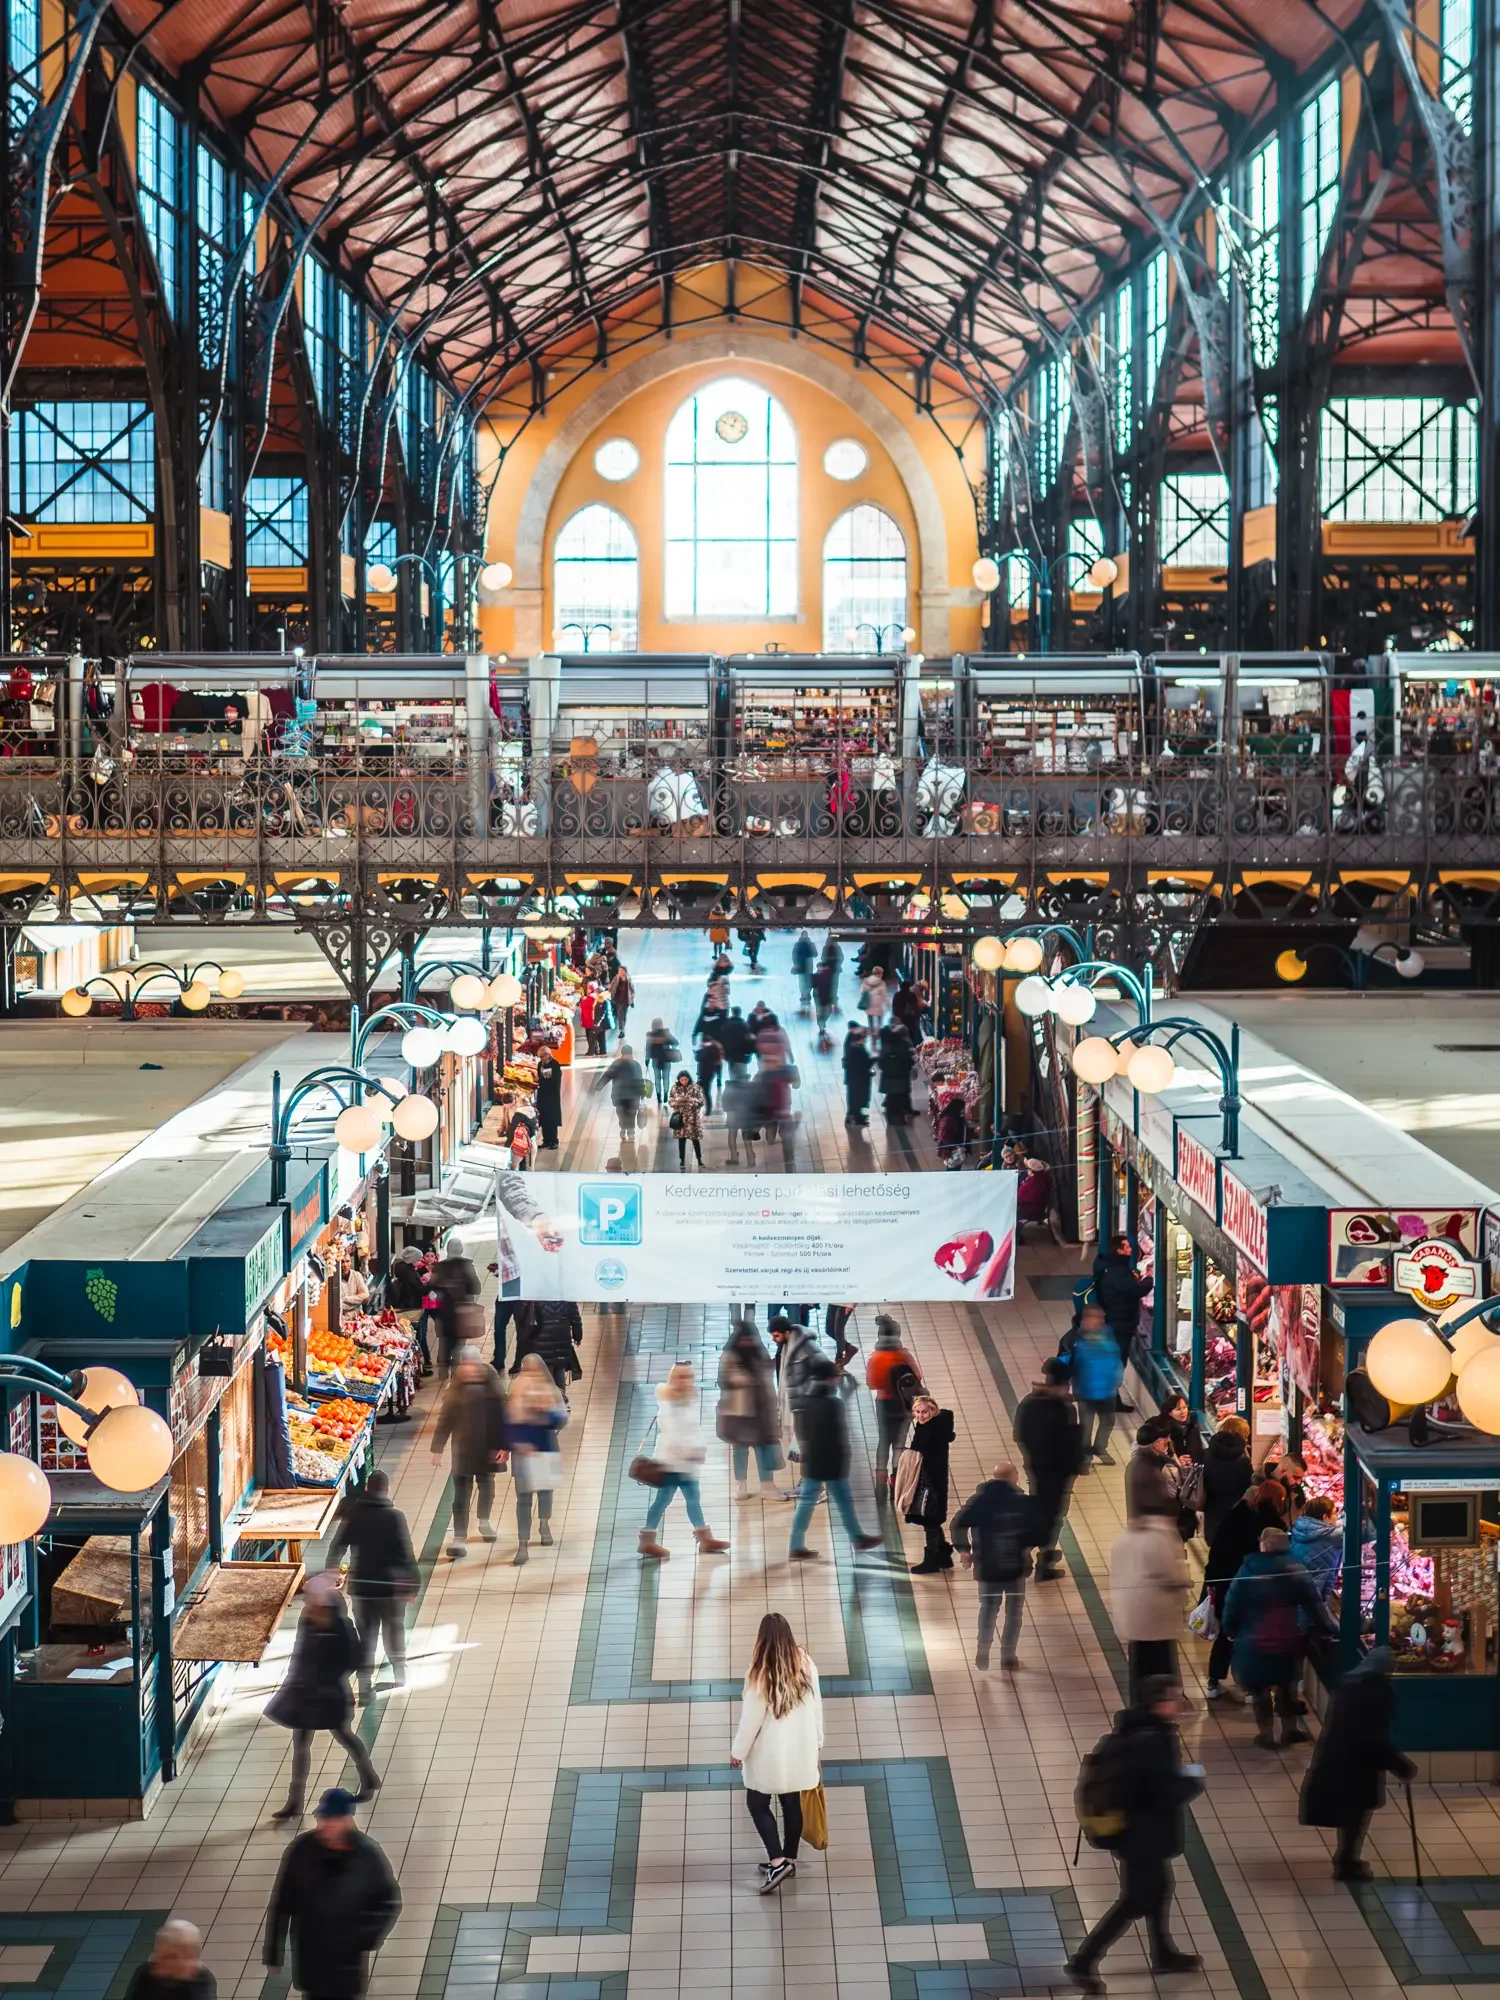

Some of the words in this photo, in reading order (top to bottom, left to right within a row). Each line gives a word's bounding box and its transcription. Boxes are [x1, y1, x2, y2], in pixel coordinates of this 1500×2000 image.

[665, 1184, 771, 1201] Kedvezményes
[775, 1184, 838, 1200] parkolási
[842, 1183, 910, 1199] lehetőség
[600, 1197, 625, 1230] P
